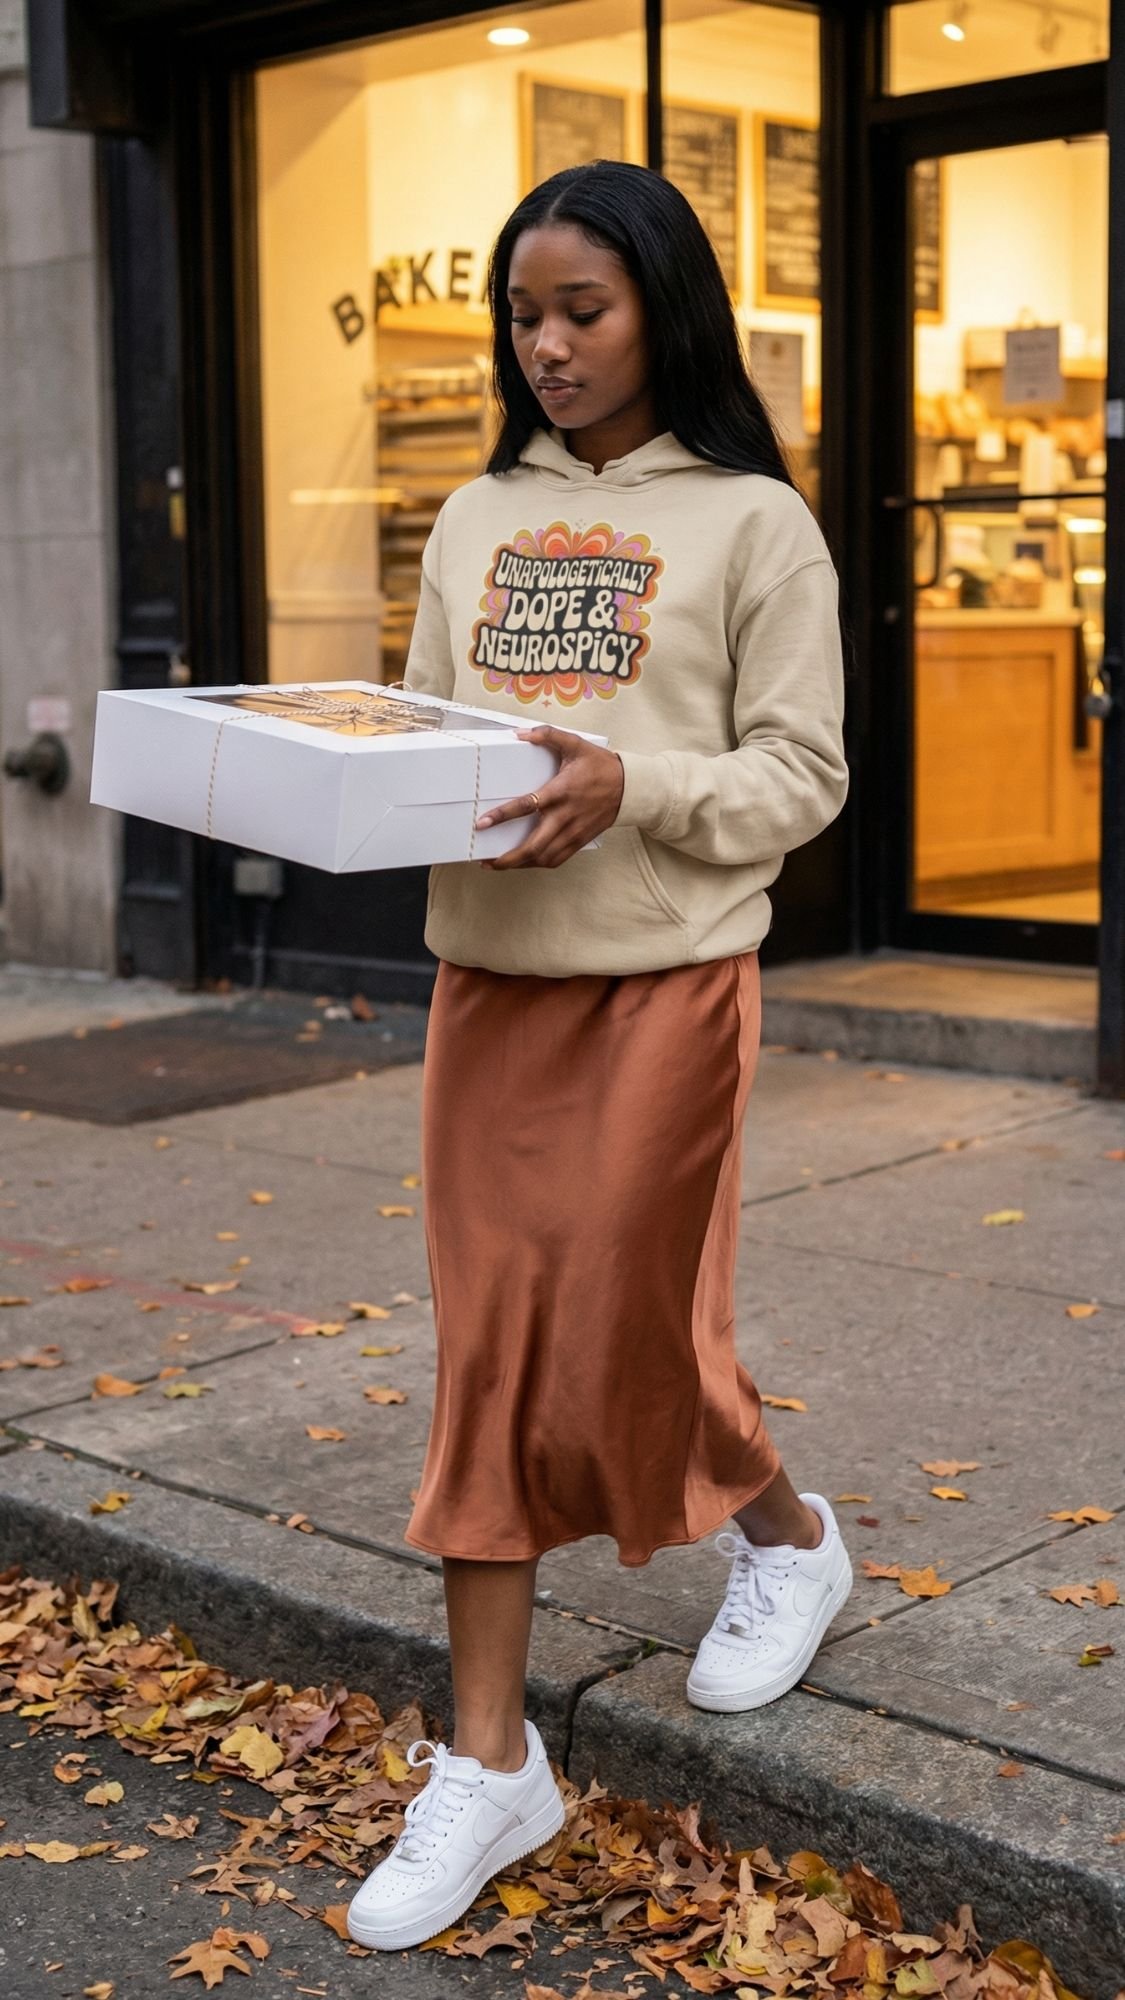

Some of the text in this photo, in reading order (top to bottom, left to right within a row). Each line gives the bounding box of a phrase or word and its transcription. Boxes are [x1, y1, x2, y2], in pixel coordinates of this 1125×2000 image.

[332, 250, 490, 345] BAKE
[504, 589, 615, 631] DOPE &
